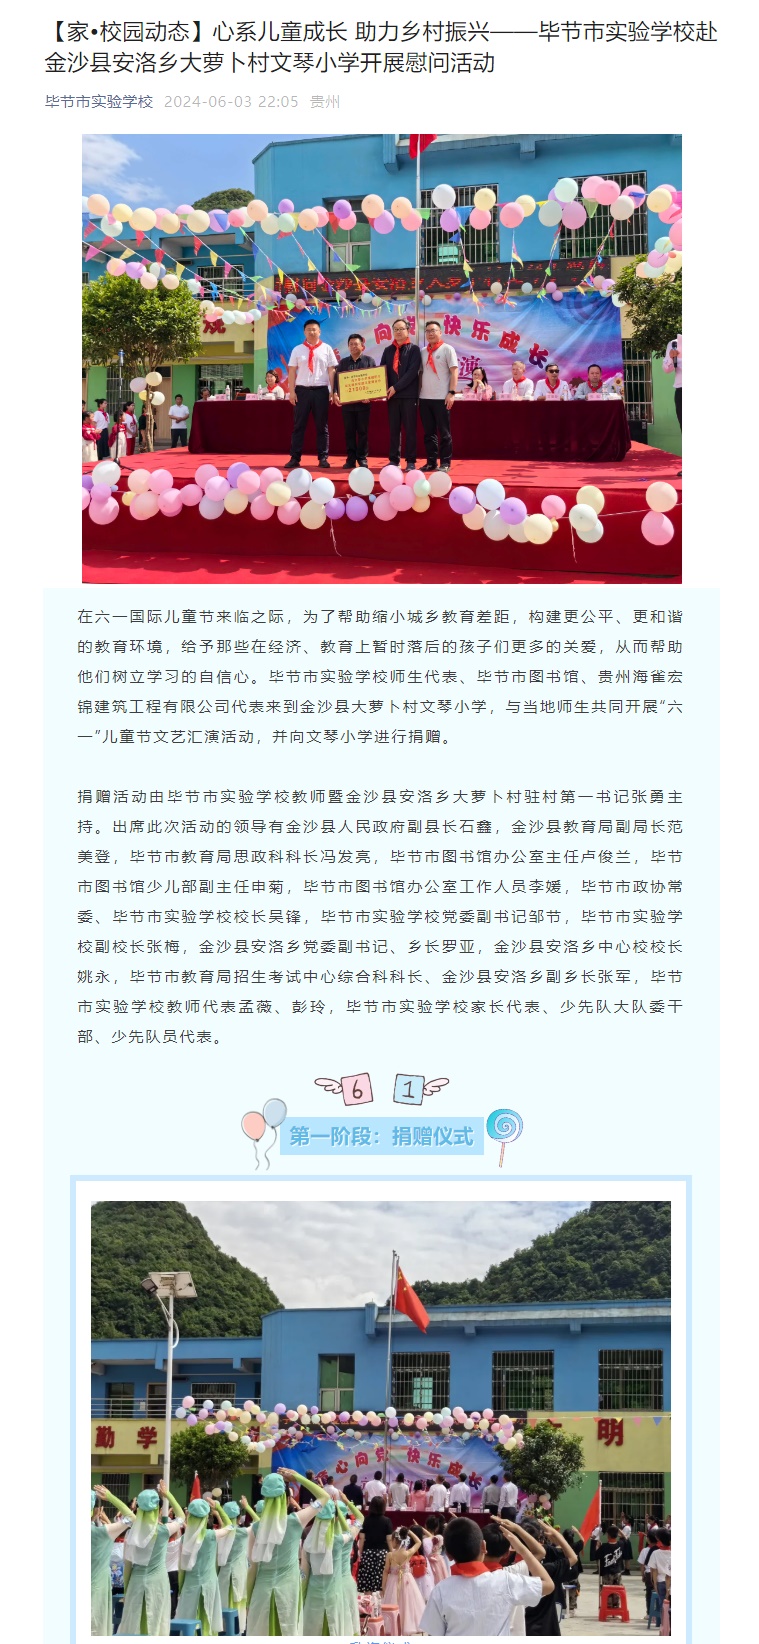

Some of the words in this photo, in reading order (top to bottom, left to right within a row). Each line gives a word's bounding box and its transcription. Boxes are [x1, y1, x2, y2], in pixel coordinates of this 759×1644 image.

[45, 51, 495, 74] 金沙县安洛乡大萝卜村文琴小学开展慰问活动
[45, 93, 154, 109] 毕节市实验学校
[164, 95, 252, 109] 2024-06-03
[258, 95, 299, 109] 22:05
[309, 94, 341, 109] 贵州
[443, 313, 550, 370] 快乐成长
[352, 1079, 363, 1099] 6
[402, 1080, 415, 1099] 1
[289, 1125, 474, 1147] 第一阶段：捐赠仪式
